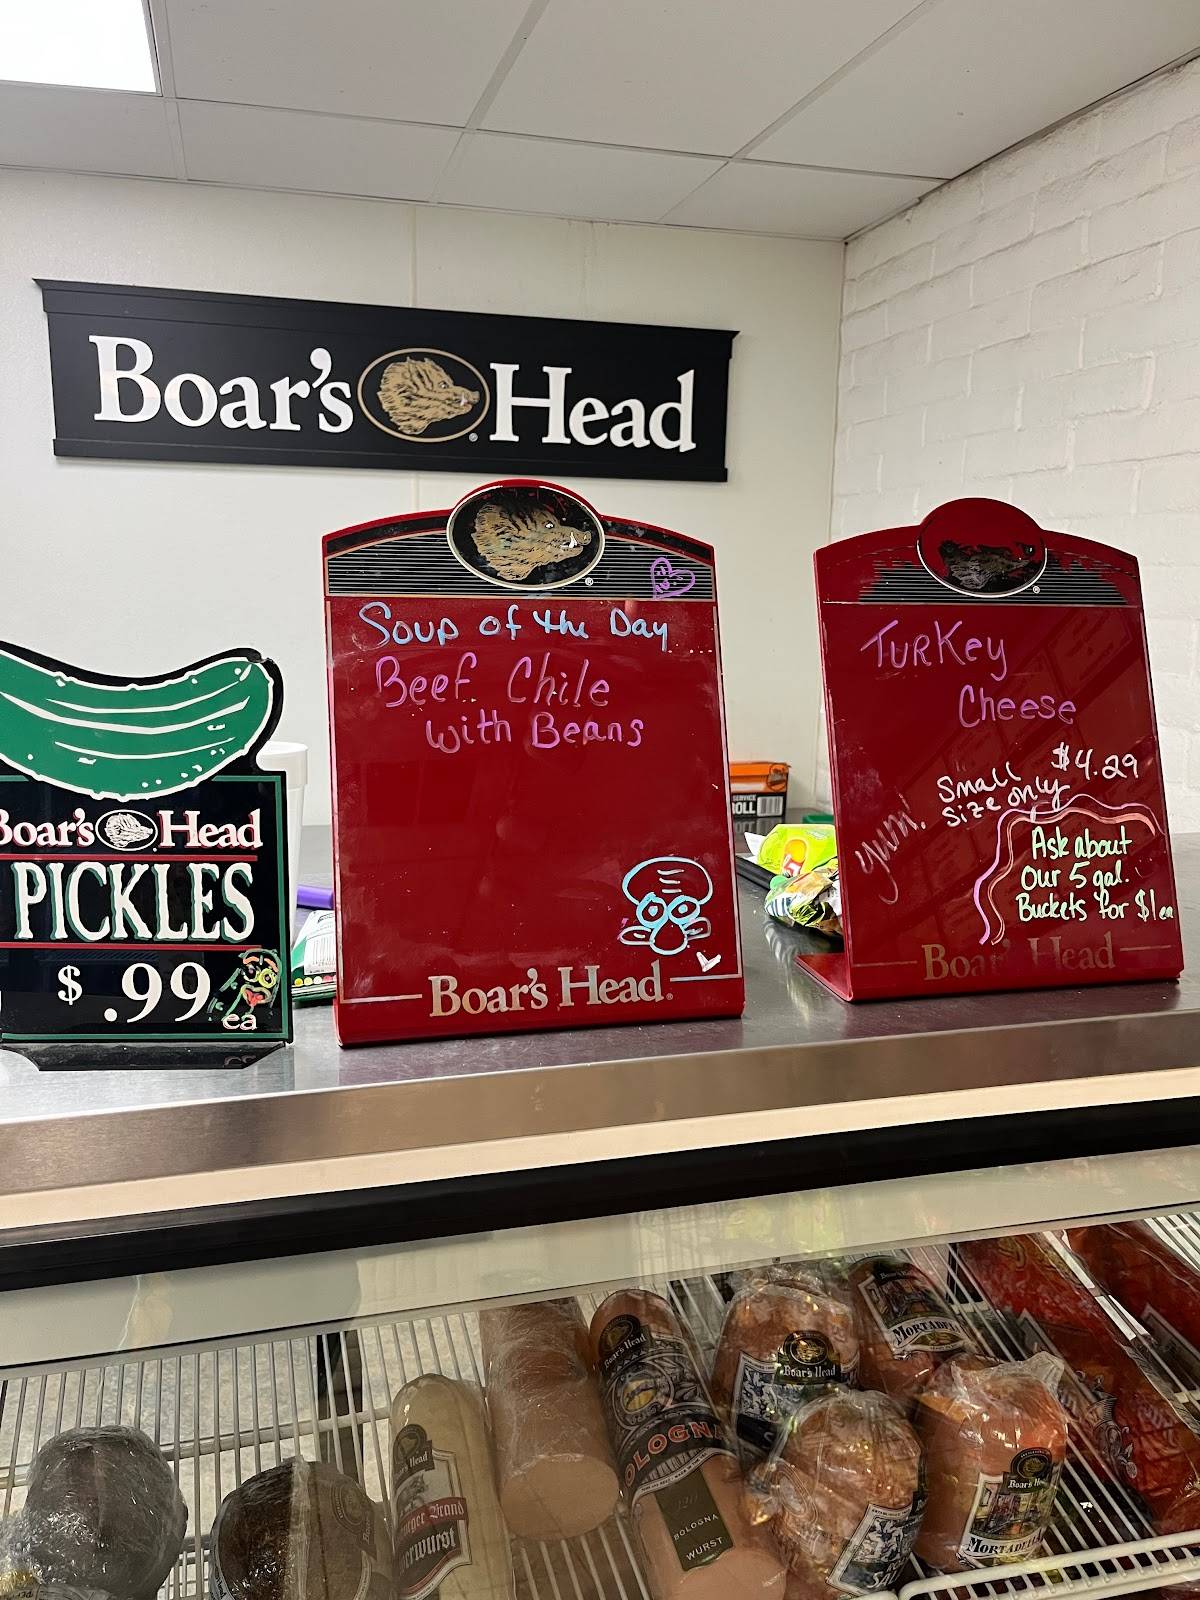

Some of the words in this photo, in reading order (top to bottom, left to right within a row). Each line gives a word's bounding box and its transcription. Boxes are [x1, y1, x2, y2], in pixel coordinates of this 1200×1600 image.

[88, 334, 355, 434] Boar's
[489, 362, 697, 453] Head
[358, 601, 459, 648] Soup
[479, 603, 522, 642] of
[533, 608, 590, 639] the
[609, 606, 669, 652] Day
[375, 651, 477, 708] Beef
[506, 651, 611, 707] Chile
[958, 684, 1078, 728] Cheese
[425, 708, 512, 753] with
[531, 711, 645, 749] Beans
[936, 760, 1022, 803] Small
[1051, 741, 1140, 781] $4.29
[1007, 775, 1071, 816] only
[156, 808, 264, 849] Head
[1031, 825, 1070, 860] Ask
[1074, 825, 1133, 859] about
[1069, 860, 1091, 889] 5
[11, 861, 255, 943] PICKLES
[1015, 891, 1088, 922] Buckets
[1097, 888, 1129, 920] for
[57, 963, 84, 1006] $
[102, 960, 212, 1024] .99
[220, 1011, 258, 1032] ea
[427, 967, 547, 1018] Boar's
[557, 960, 665, 1008] Head
[673, 1513, 719, 1541] BOLOGNA
[685, 1536, 724, 1561] WURST
